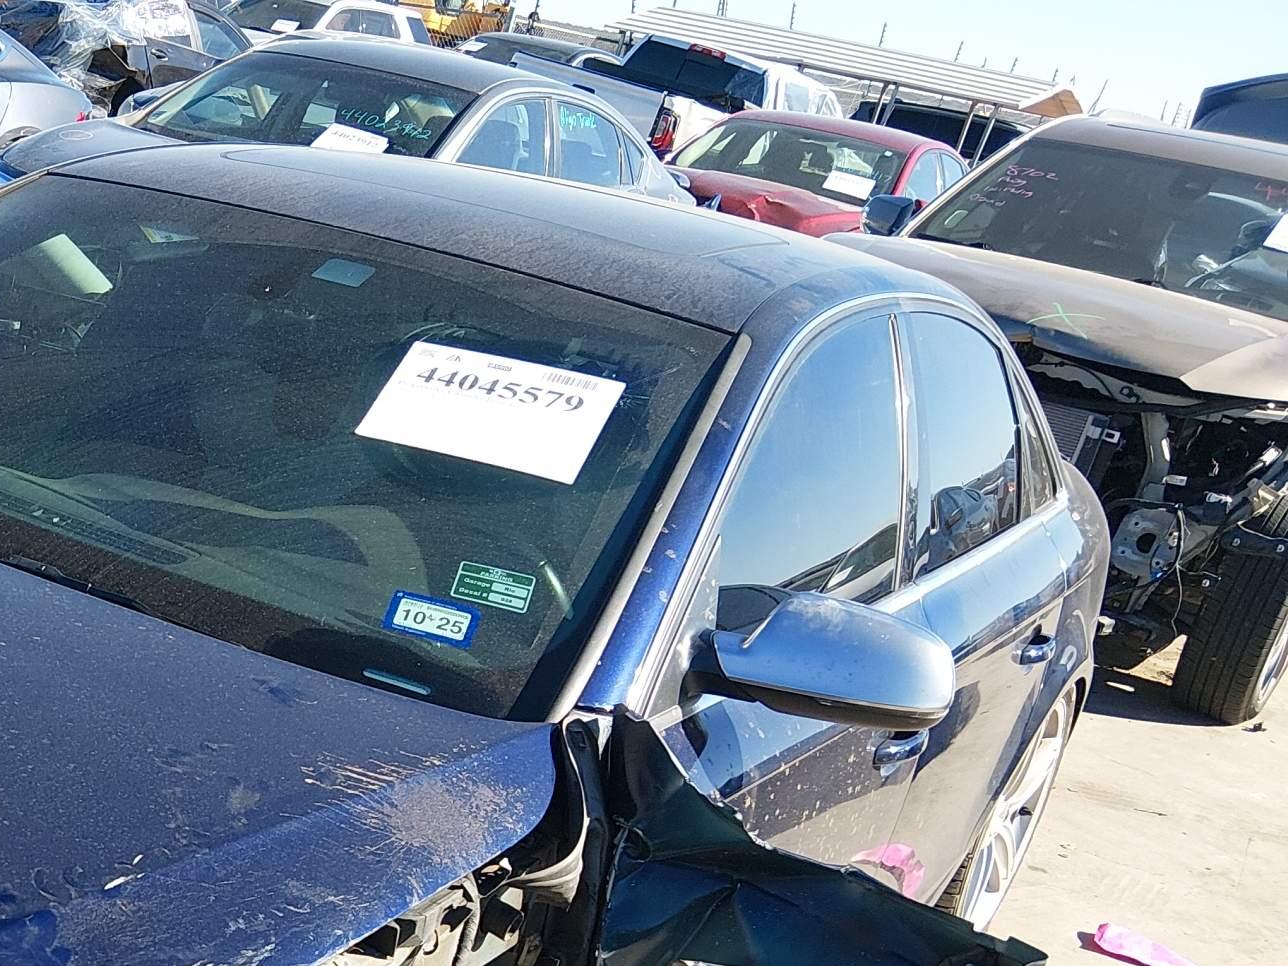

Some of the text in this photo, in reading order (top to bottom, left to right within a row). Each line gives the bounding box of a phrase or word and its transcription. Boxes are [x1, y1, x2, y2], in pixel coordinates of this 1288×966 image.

[416, 367, 585, 412] 44045579
[458, 586, 481, 597] Decal
[463, 577, 491, 588] Garage
[402, 608, 427, 625] 10
[435, 616, 465, 635] 25
